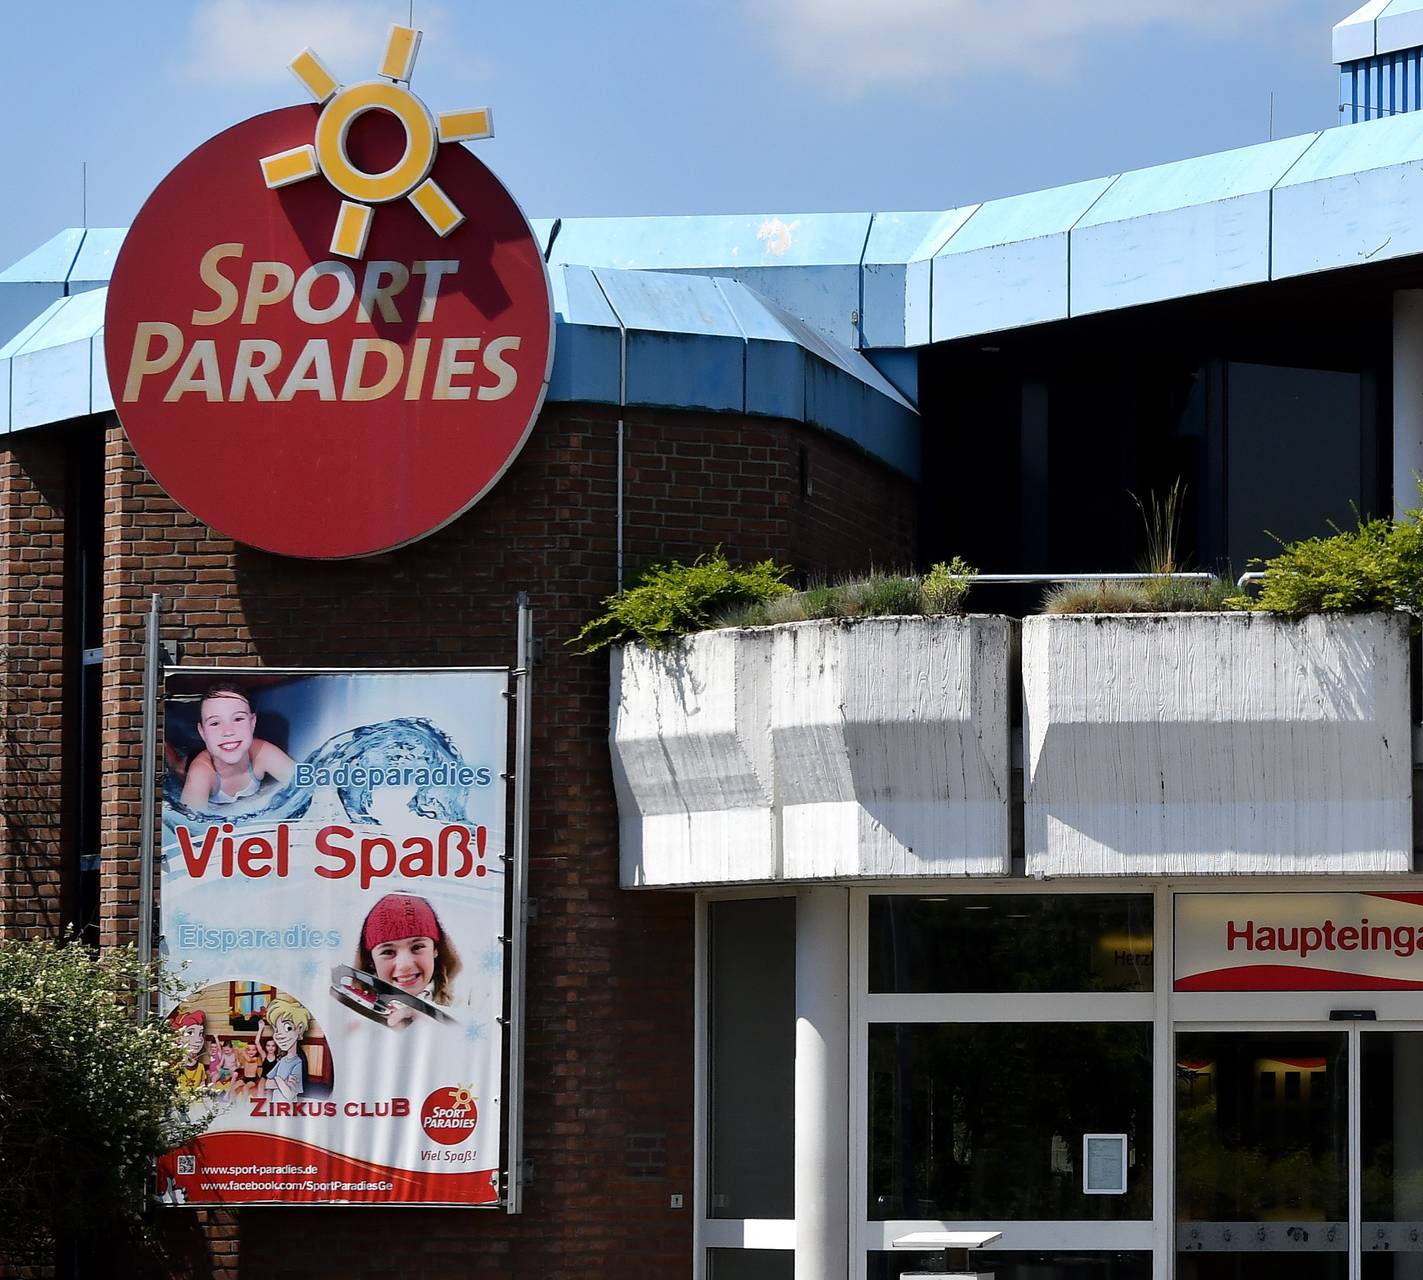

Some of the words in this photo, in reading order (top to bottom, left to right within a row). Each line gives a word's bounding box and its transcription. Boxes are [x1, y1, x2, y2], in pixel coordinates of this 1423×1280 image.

[191, 242, 460, 326] SPORT
[122, 321, 521, 403] PARADIES
[294, 762, 492, 791] Badeparadies
[175, 822, 290, 879] Viel
[314, 822, 489, 890] Spaß!
[178, 923, 342, 954] Eisparadies
[250, 1096, 338, 1118] ZIRKUS
[432, 1105, 467, 1119] SPORT
[423, 1116, 475, 1129] PARADIES
[420, 1150, 441, 1162] Viel
[444, 1150, 477, 1164] Spaß!
[200, 1164, 319, 1176] www.sport-paradies.de
[200, 1180, 394, 1192] www.facebook.com/SportParadiesGe
